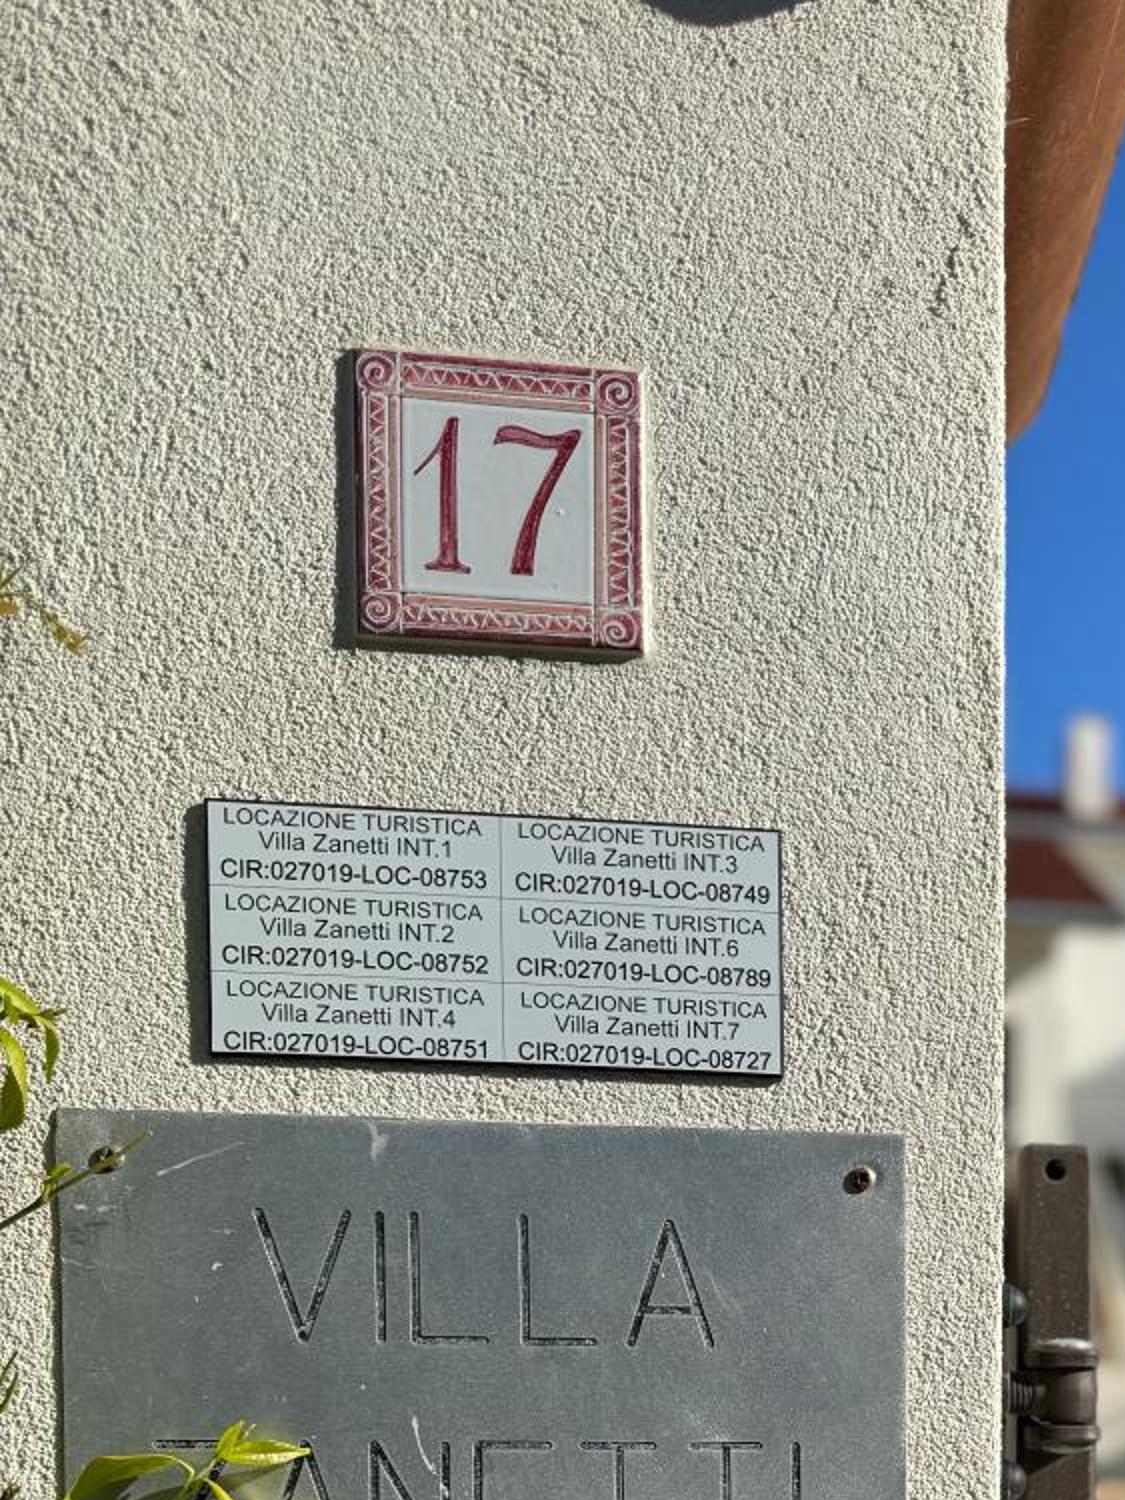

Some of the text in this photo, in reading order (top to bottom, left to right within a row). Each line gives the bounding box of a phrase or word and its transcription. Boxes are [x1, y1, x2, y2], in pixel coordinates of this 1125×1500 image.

[414, 416, 582, 576] 17
[223, 807, 481, 836] LOCAZIONE TURISTICA
[259, 831, 451, 858] Villa Zanetti INT.1
[518, 823, 765, 852] LOCAZIONE TURISTICA
[221, 859, 487, 889] CIR:027019-LOC-08753
[551, 846, 737, 874] Villa Zanetti INT.3
[516, 873, 769, 904] CIR:027019-LOC-08749
[225, 893, 483, 921] LOCAZIONE TURISTICA
[519, 906, 766, 935] LOCAZIONE TURISTICA
[260, 917, 454, 943] Villa Zanetti INT.2
[552, 930, 739, 957] Villa Zanetti INT.6
[222, 945, 488, 974] CIR:027019-LOC-08752
[517, 958, 771, 987] CIR:027019-LOC-08789
[226, 980, 484, 1005] LOCAZIONE TURISTICA
[520, 992, 767, 1018] LOCAZIONE TURISTICA
[261, 1003, 456, 1028] Villa Zanetti INT.4
[554, 1015, 740, 1040] Villa Zanetti INT.7
[223, 1031, 488, 1058] CIR:027019-LOC-08751
[518, 1042, 772, 1070] CIR:027019-LOC-08727
[253, 1207, 714, 1347] VILLA
